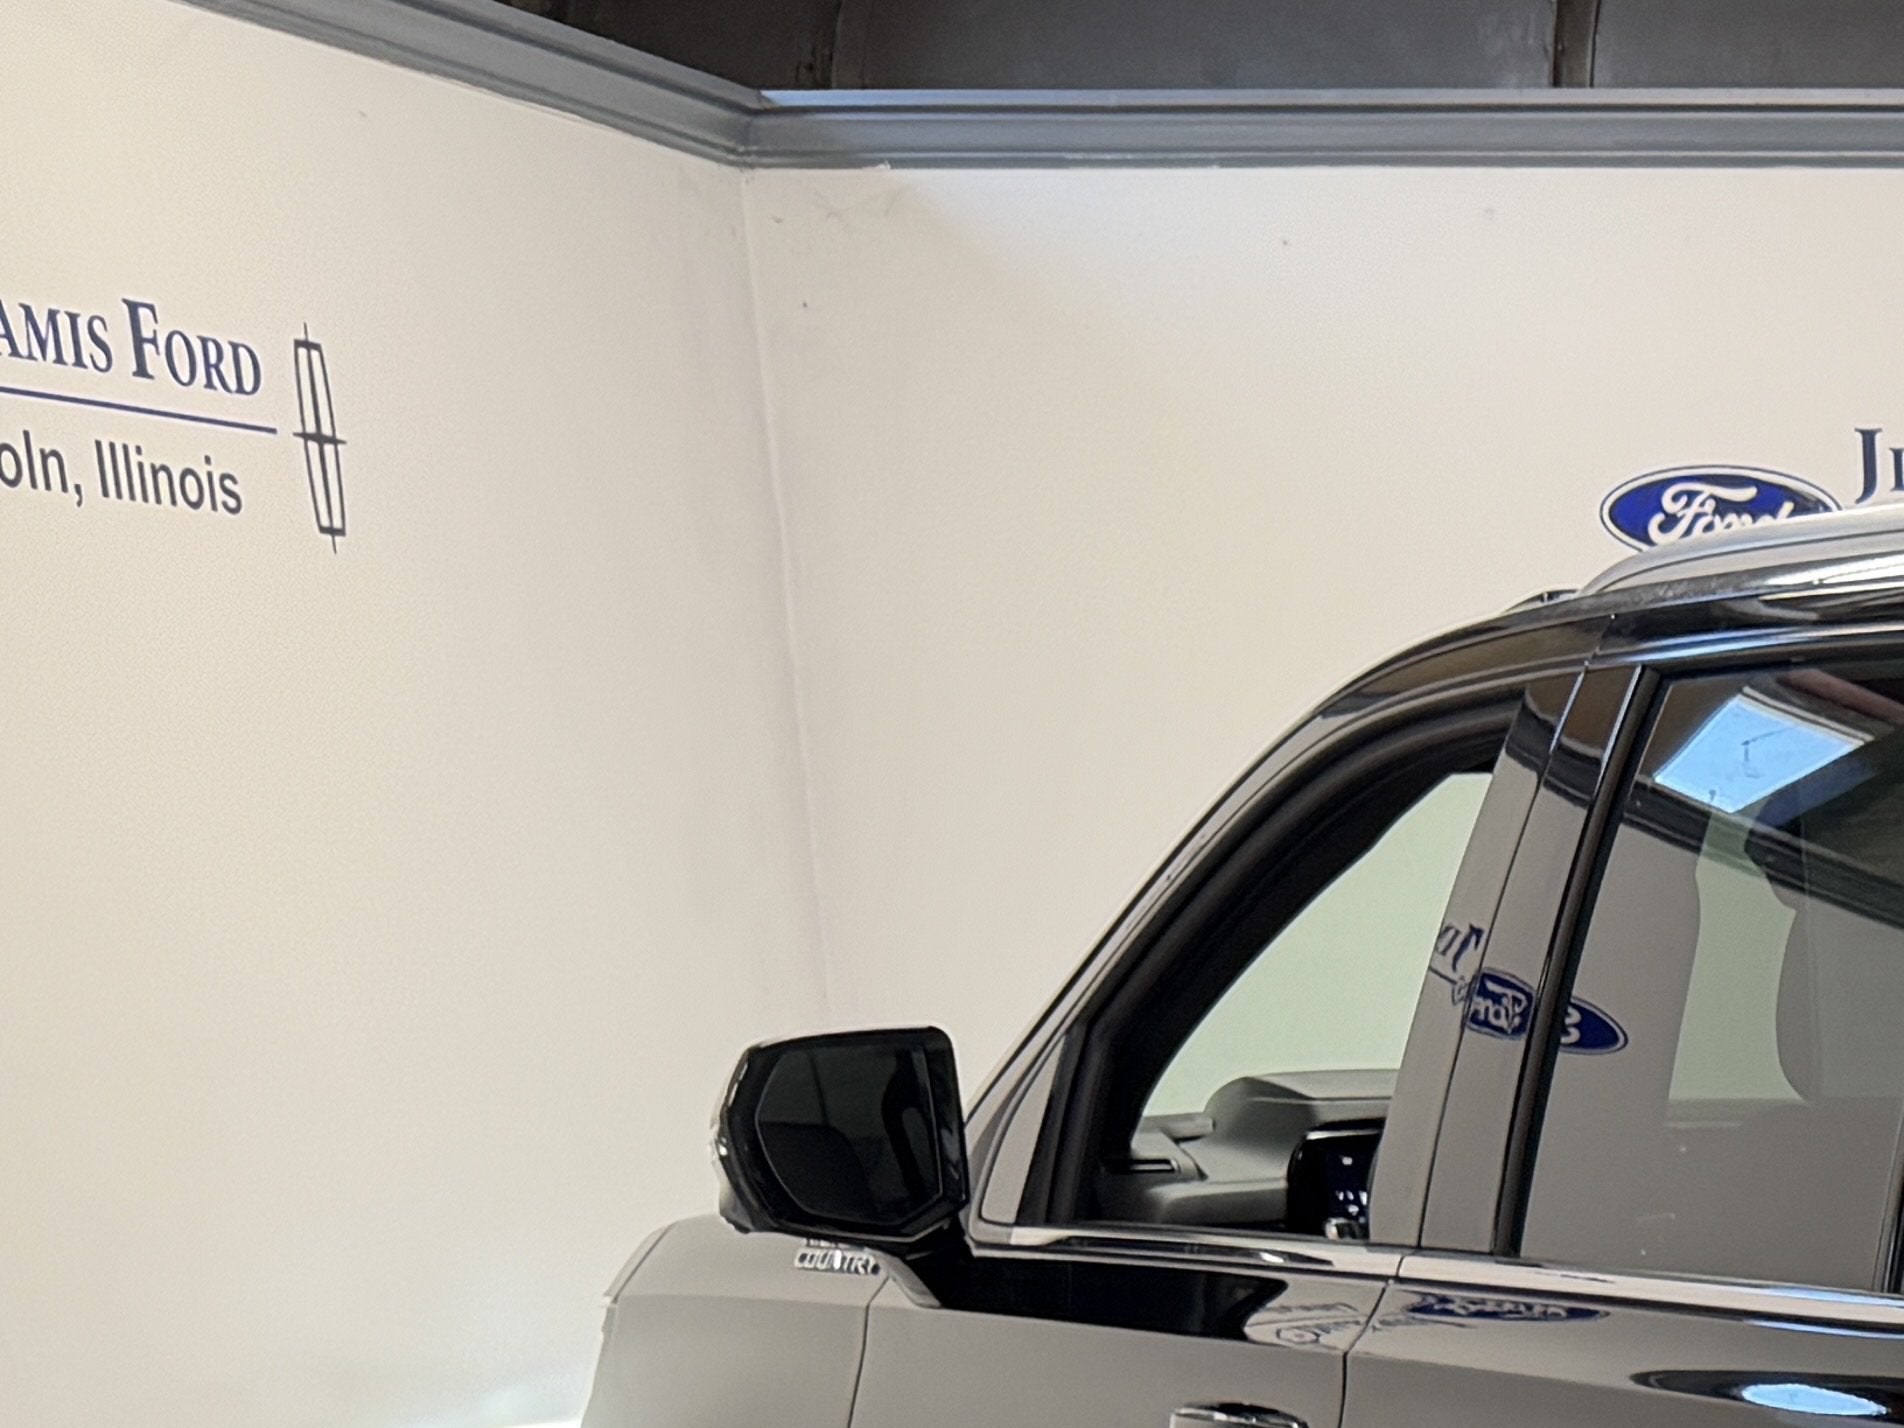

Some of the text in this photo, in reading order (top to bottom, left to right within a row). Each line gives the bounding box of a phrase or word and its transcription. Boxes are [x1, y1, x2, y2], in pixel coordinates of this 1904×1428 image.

[0, 298, 263, 396] AMIS FORD
[95, 440, 243, 515] Illinois
